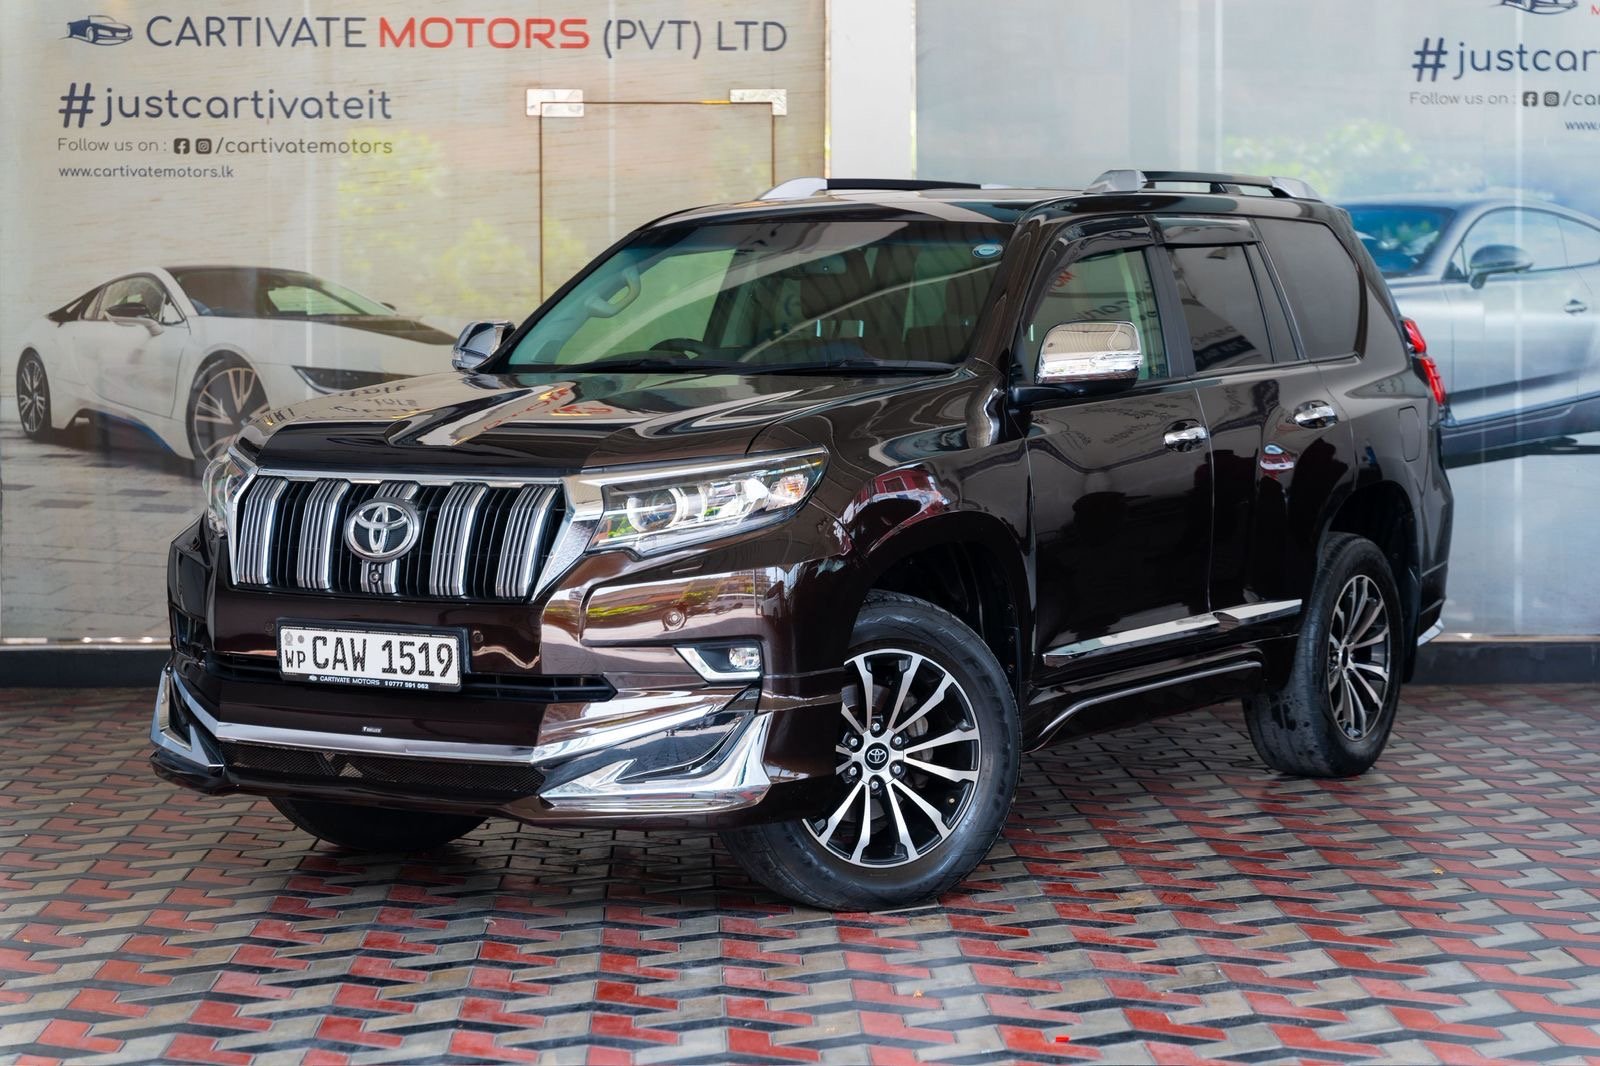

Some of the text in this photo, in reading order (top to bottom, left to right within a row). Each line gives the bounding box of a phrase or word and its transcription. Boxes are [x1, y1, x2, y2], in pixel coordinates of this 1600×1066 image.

[146, 15, 787, 59] CARTIVATE MOTORS (PVT) LTD
[58, 82, 392, 129] #justcartivateit
[1409, 91, 1461, 105] Follow
[1464, 94, 1483, 105] us
[57, 137, 109, 151] Follow
[114, 140, 133, 151] us
[215, 137, 393, 154] /cartivatemotors
[58, 165, 235, 178] www.cartivatemotors.lk
[284, 635, 453, 677] WP CAW 1519
[319, 675, 351, 684] CARTIVATE
[352, 678, 380, 686] MOTORS
